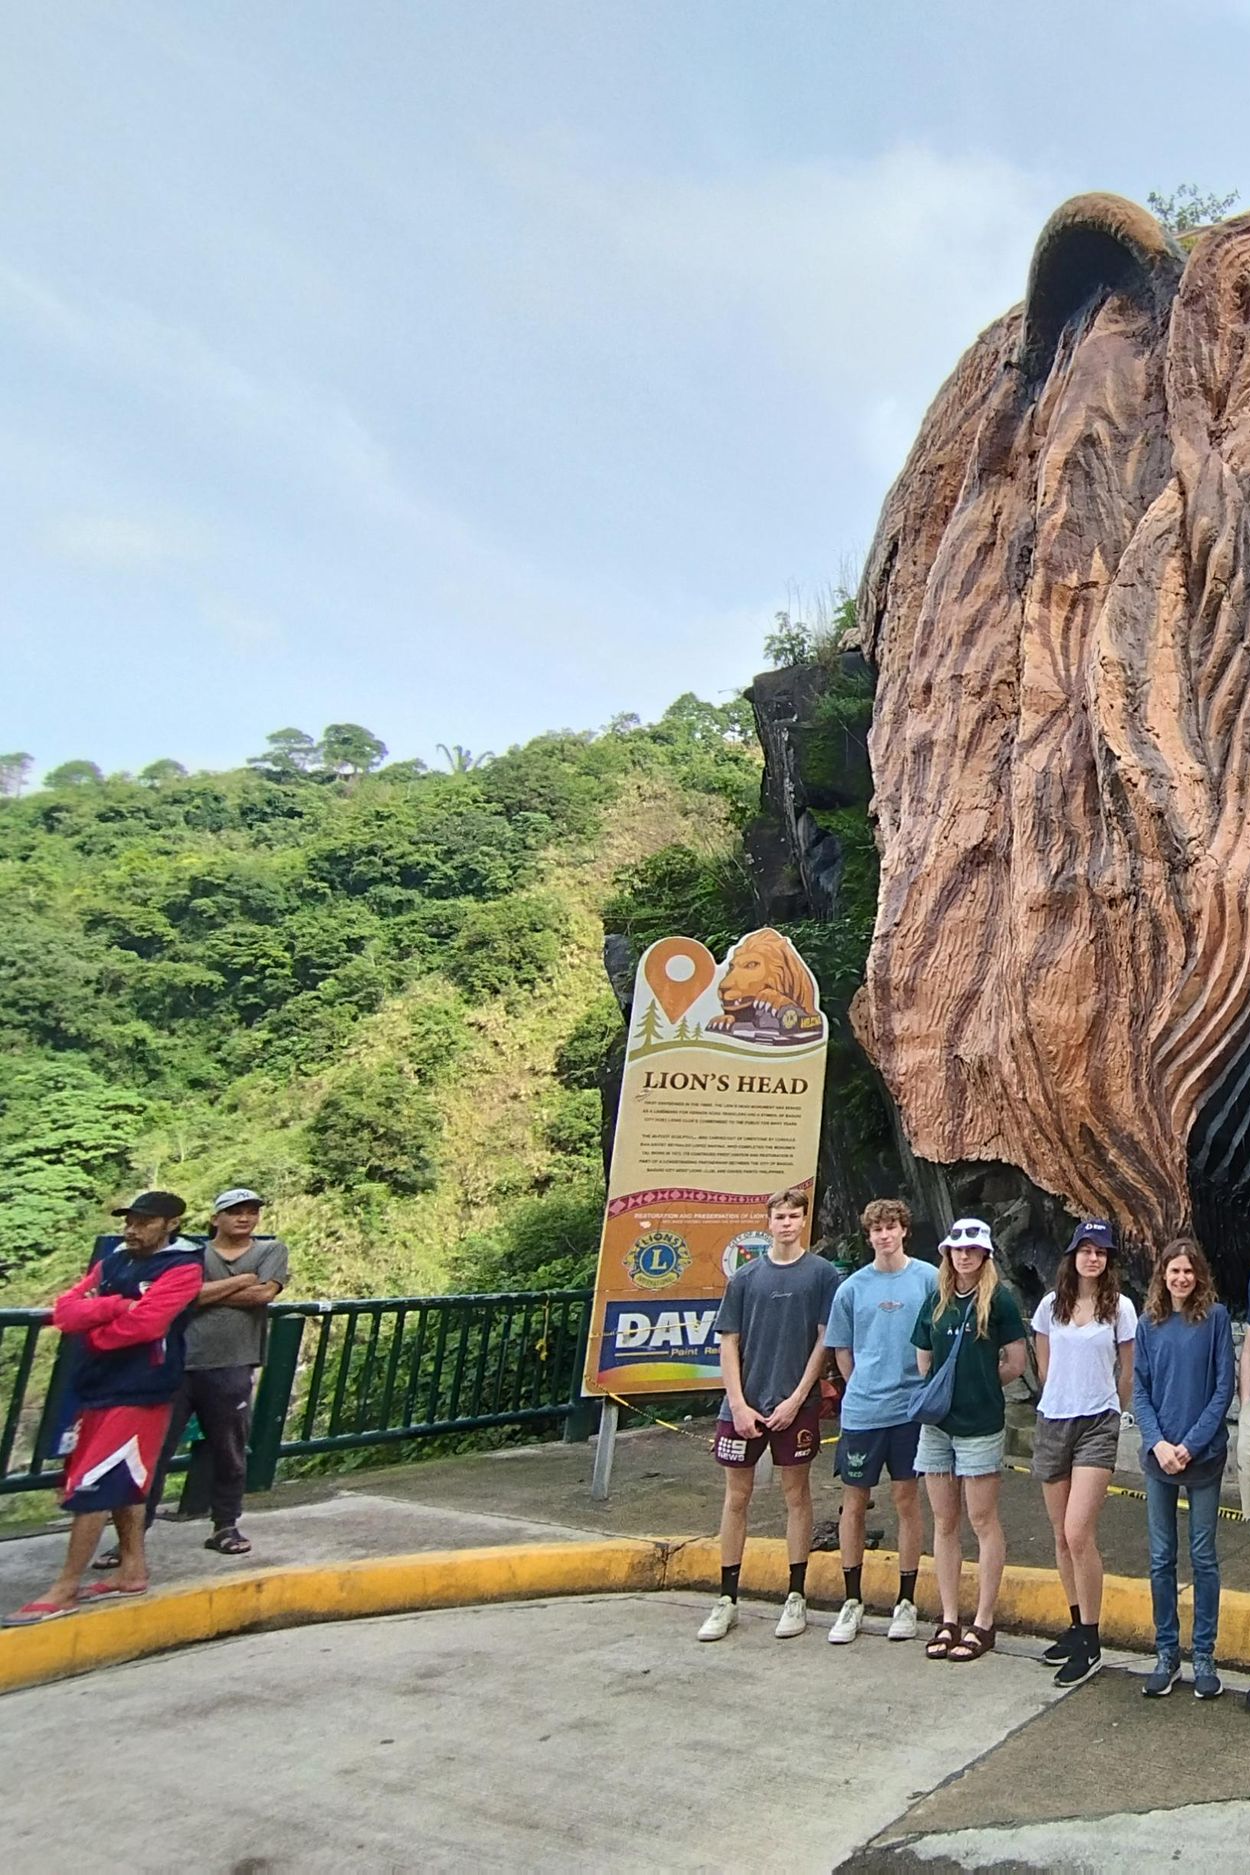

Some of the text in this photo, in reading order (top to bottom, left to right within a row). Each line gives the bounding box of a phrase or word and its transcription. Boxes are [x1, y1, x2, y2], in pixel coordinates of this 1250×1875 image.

[643, 1071, 809, 1095] LION'S HEAD
[641, 1232, 683, 1248] LIONS
[649, 1249, 667, 1270] L
[670, 1347, 698, 1357] Paint
[731, 1439, 747, 1455] 9
[718, 1451, 745, 1462] NEWS
